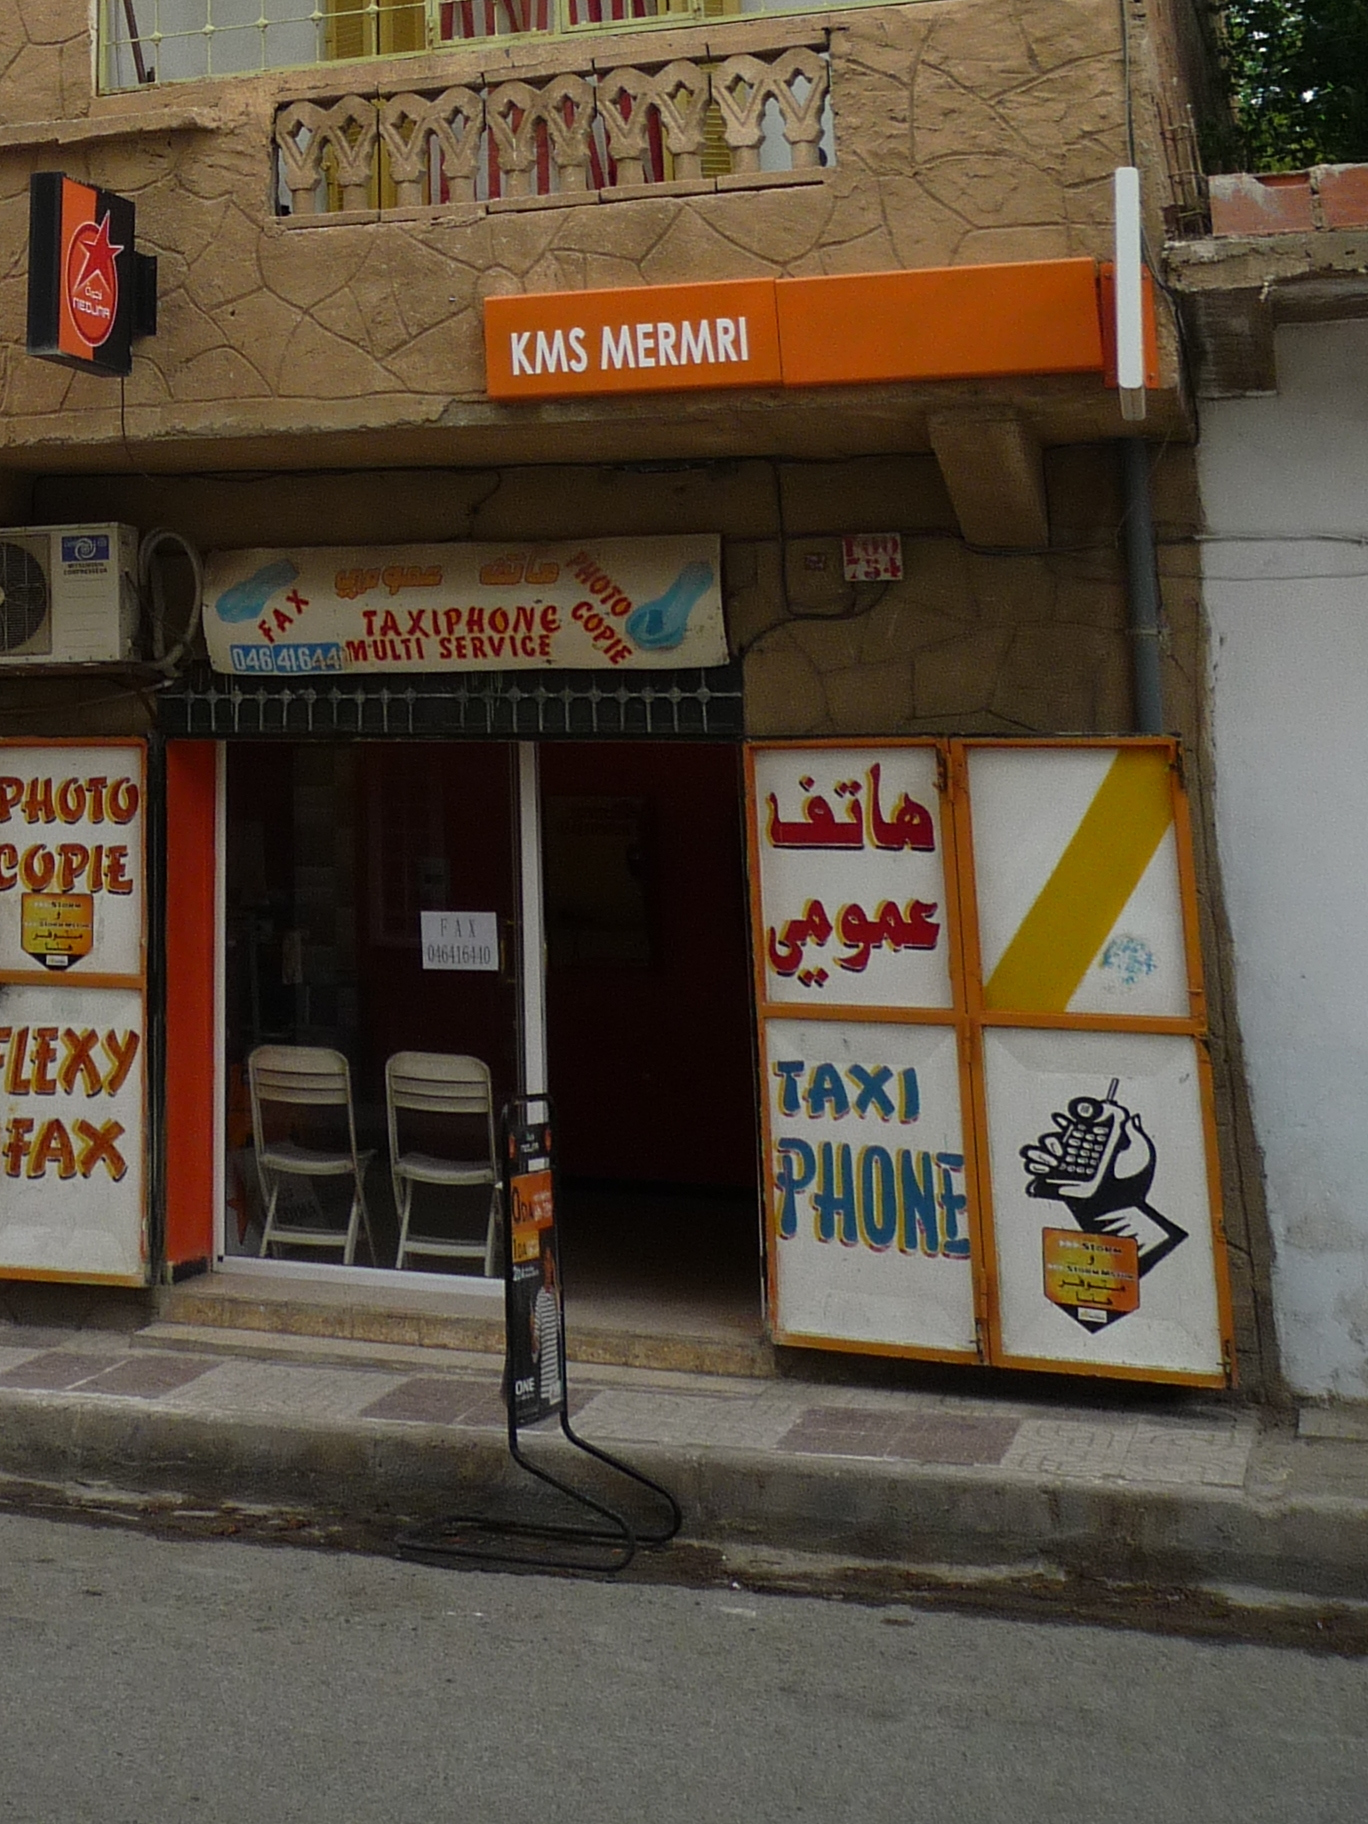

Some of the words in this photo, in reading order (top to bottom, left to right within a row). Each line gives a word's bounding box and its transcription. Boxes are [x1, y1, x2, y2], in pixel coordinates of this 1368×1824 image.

[510, 327, 588, 376] KMS
[600, 317, 749, 371] MERMRI
[257, 587, 310, 644] FAX
[565, 551, 634, 618] PHOTO
[345, 639, 425, 663] MULTI
[438, 634, 551, 661] SERVICE
[361, 604, 562, 640] TAXIPHONE
[570, 600, 634, 667] COPIE
[765, 762, 935, 852] هاتف
[765, 898, 941, 987] عمومي
[772, 1060, 920, 1124] TAXI
[2, 1117, 129, 1182] FAX
[772, 1137, 971, 1260] PHONE
[514, 1376, 536, 1396] ONE
